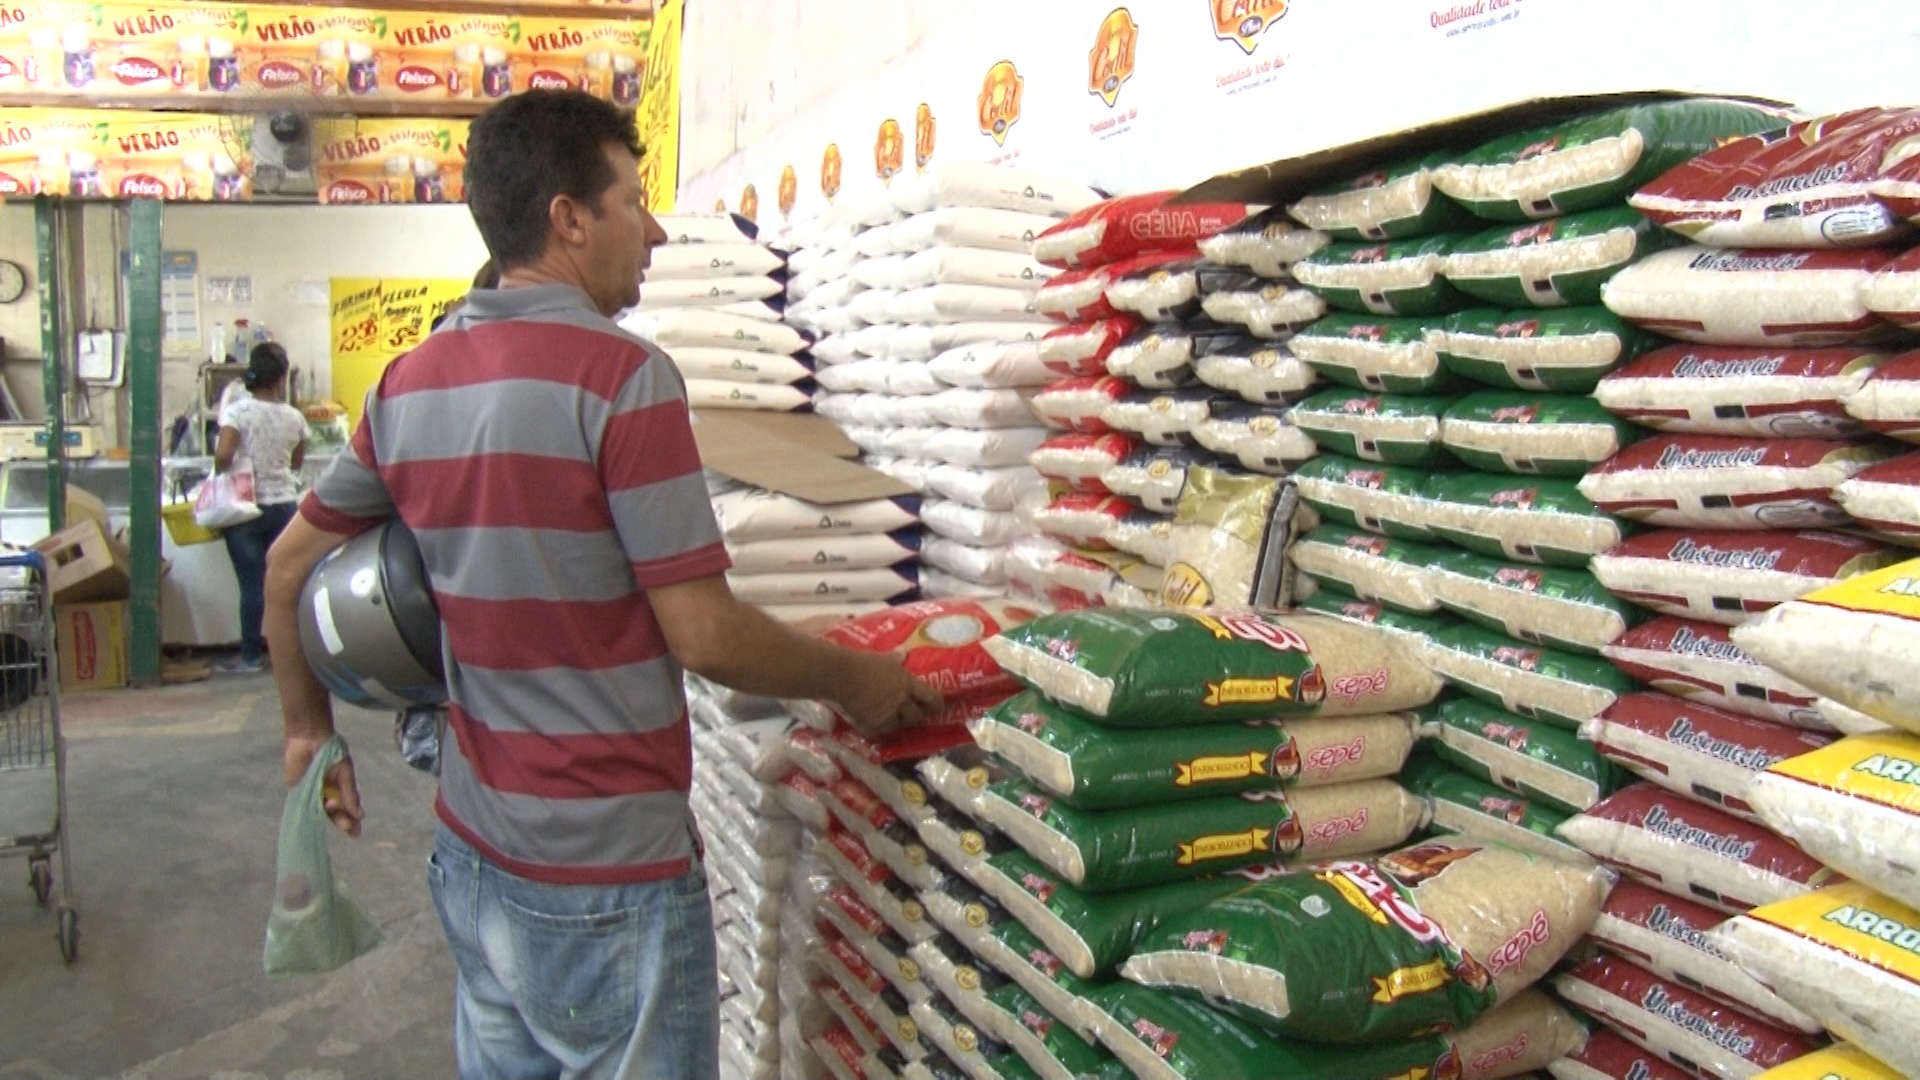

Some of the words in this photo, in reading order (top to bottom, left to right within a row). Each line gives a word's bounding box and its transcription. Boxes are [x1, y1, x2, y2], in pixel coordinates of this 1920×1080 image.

[113, 10, 175, 37] VERÃO
[256, 16, 315, 42] VERÃO
[395, 20, 451, 48] VERÃO
[528, 22, 583, 50] VERÃO
[115, 65, 159, 79] Frisco
[262, 69, 300, 82] Frisco
[399, 72, 436, 86] Frisco
[118, 128, 179, 154] VERÃO
[323, 133, 381, 162] VERÃO
[123, 180, 164, 195] Frisco
[330, 186, 367, 201] Frisco
[1332, 668, 1388, 706] sepé
[1304, 736, 1366, 780] sepé
[1308, 809, 1368, 852] sepé
[1488, 909, 1552, 977] sepé
